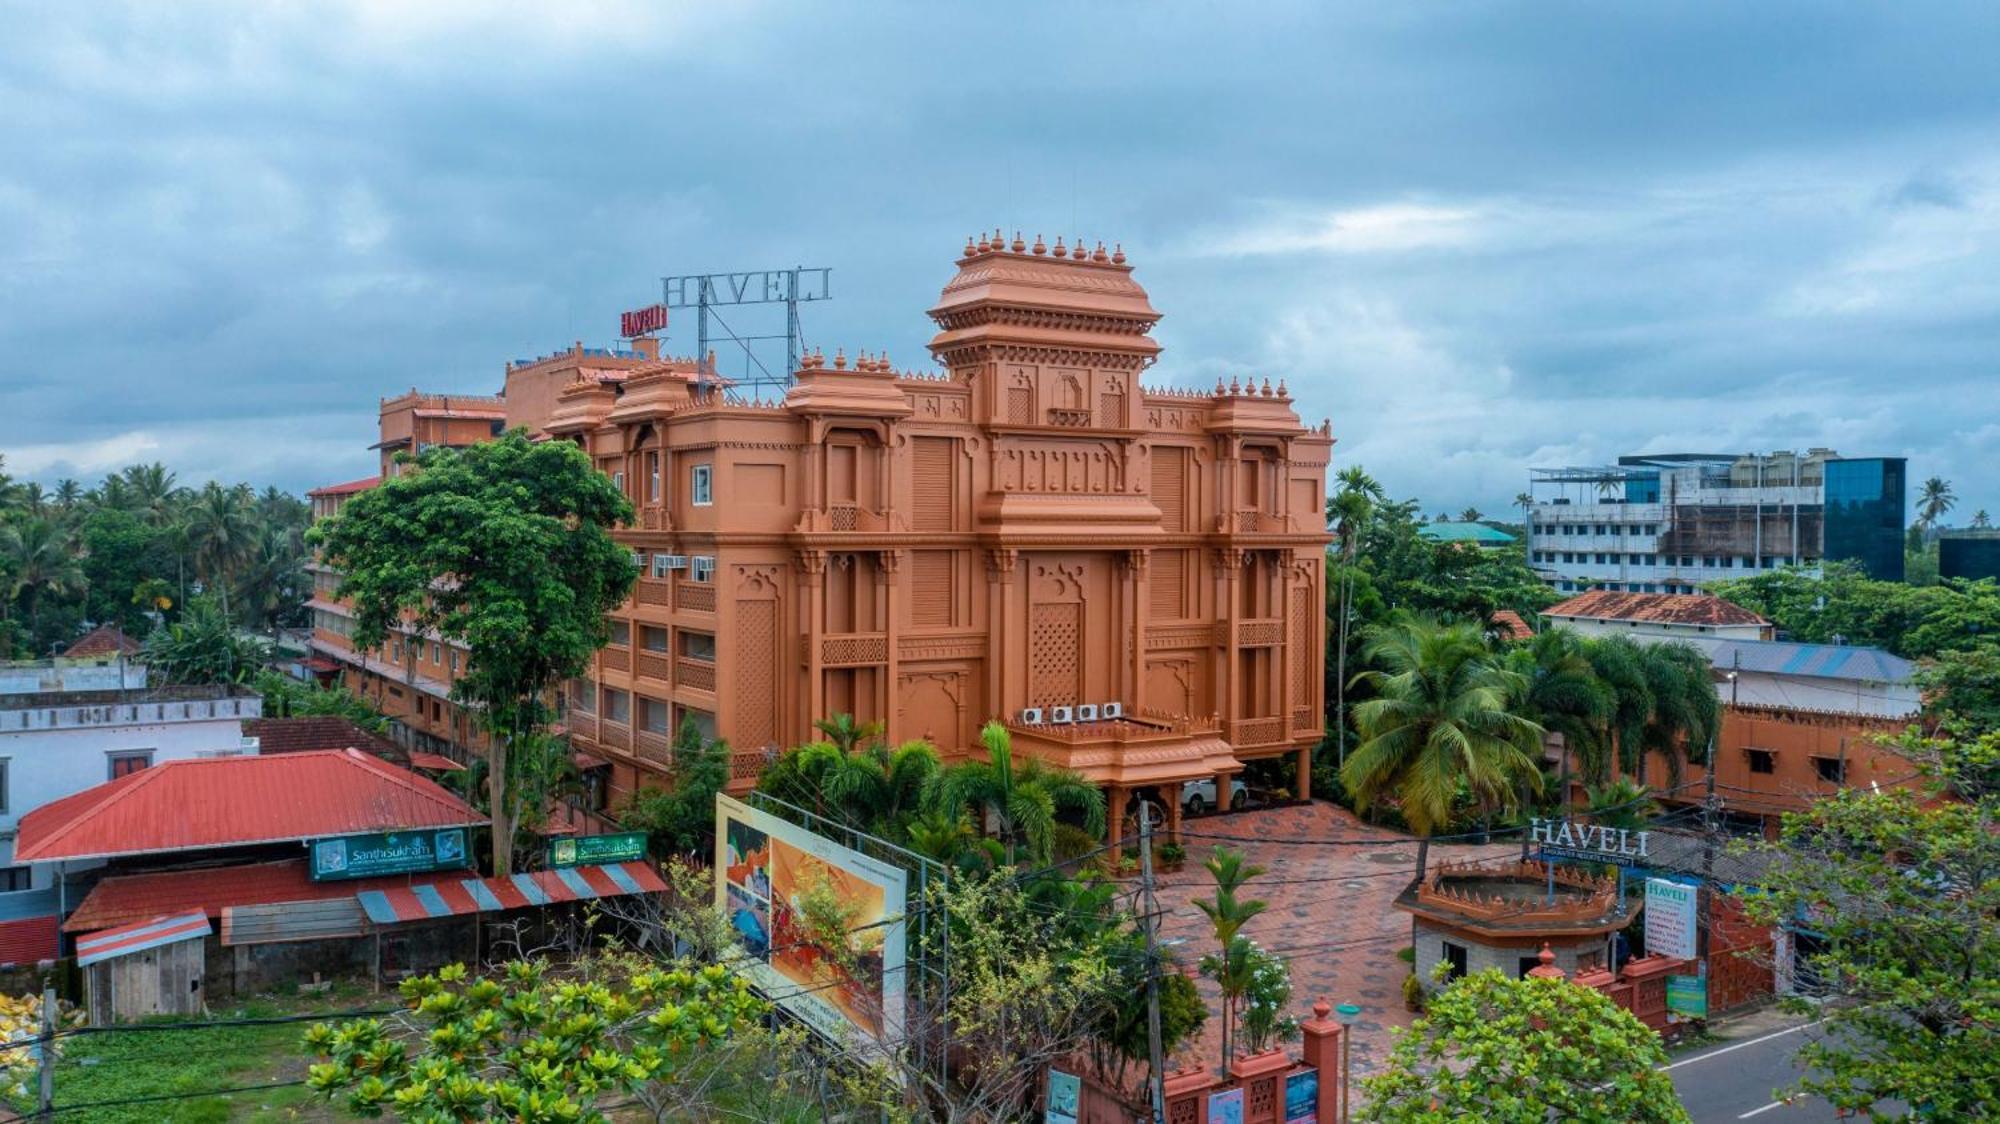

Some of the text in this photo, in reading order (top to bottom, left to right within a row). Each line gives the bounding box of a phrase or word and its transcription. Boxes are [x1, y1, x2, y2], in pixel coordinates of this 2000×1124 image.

[661, 268, 832, 308] HAVELI
[1529, 817, 1649, 857] HAVELI
[1648, 883, 1688, 902] HAVELI
